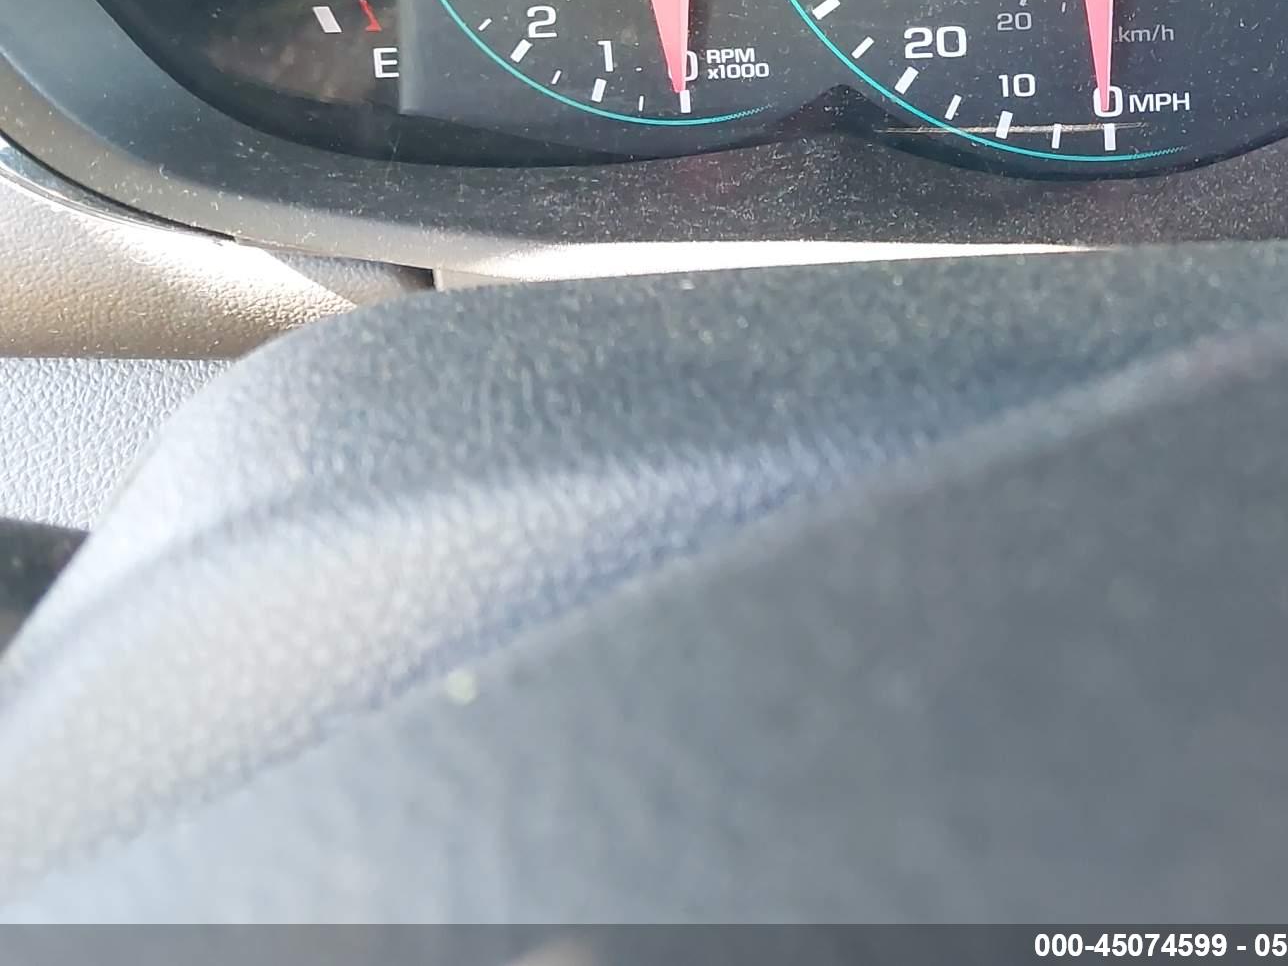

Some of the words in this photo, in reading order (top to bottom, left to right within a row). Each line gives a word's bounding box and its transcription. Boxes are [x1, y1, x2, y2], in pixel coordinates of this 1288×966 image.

[526, 5, 558, 38] 2
[996, 12, 1032, 31] 20
[1118, 24, 1175, 43] km/h
[903, 25, 967, 59] 20
[373, 47, 400, 78] E
[597, 40, 614, 72] 1
[706, 48, 756, 64] RPM
[707, 63, 770, 80] x1000
[998, 73, 1036, 98] 10
[1093, 86, 1123, 117] 0
[1129, 92, 1190, 113] MPH
